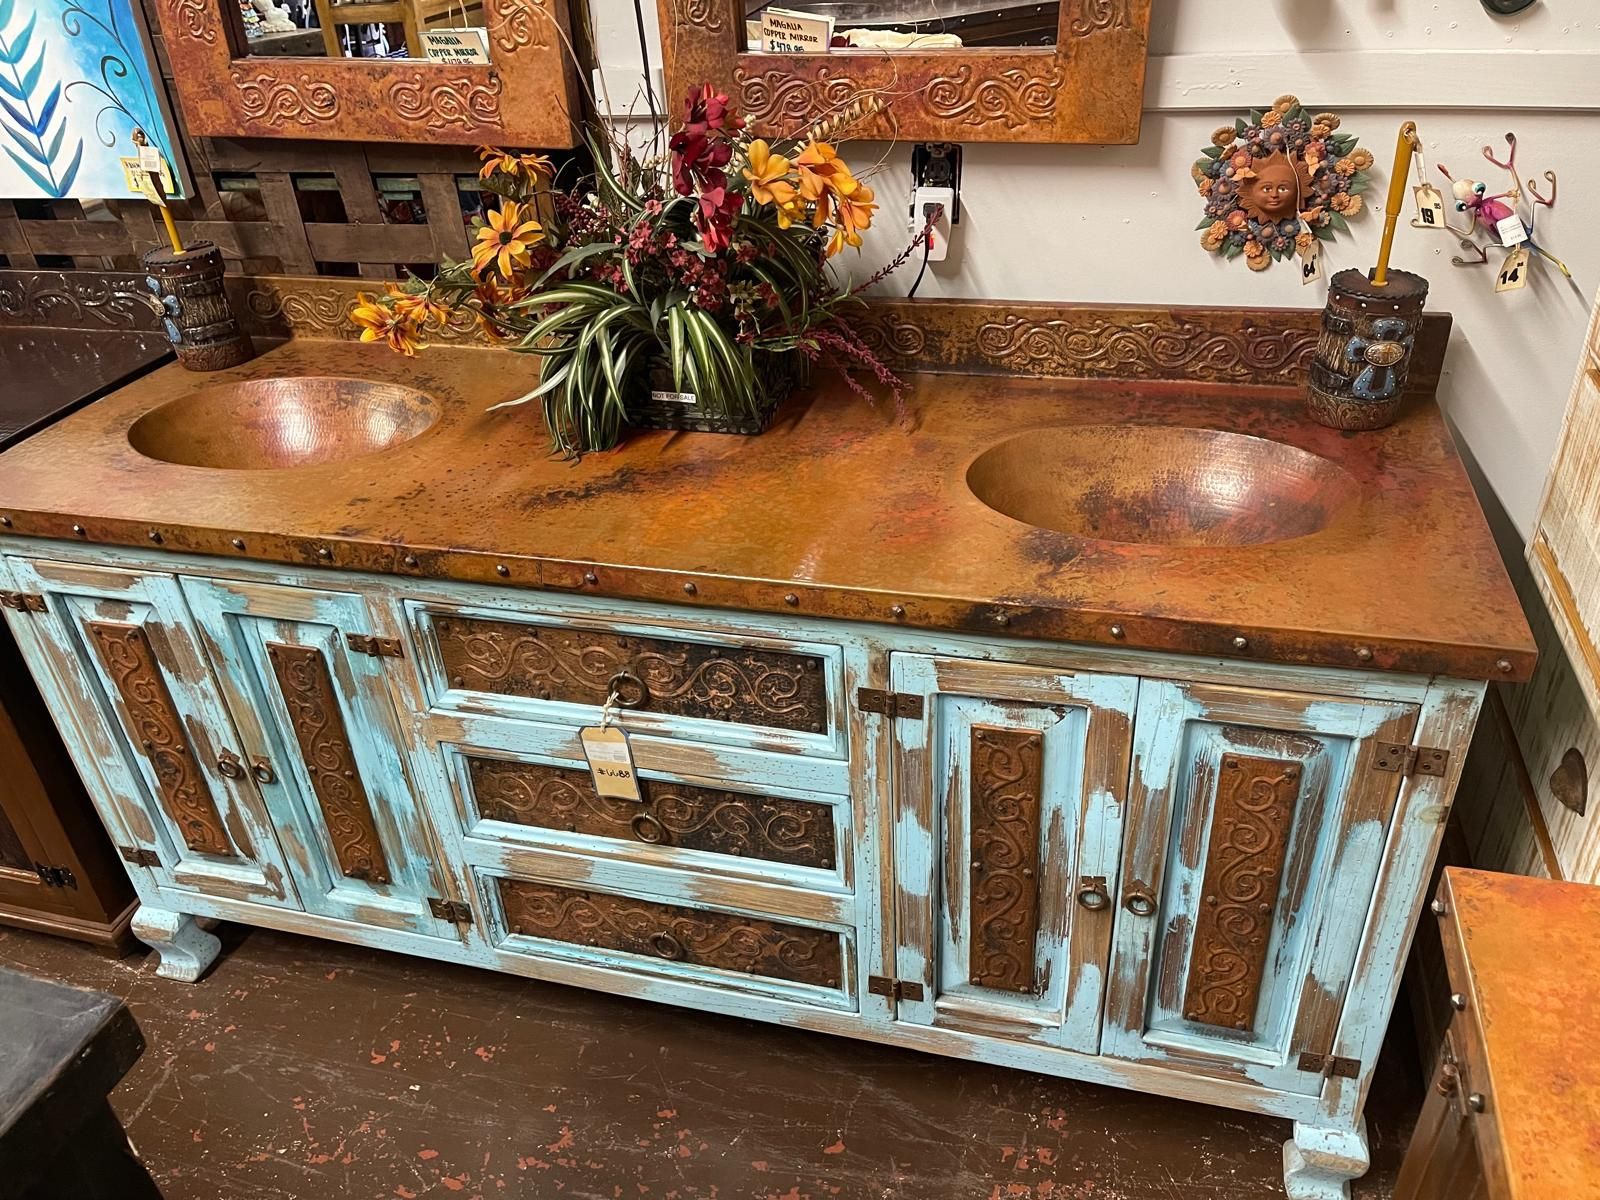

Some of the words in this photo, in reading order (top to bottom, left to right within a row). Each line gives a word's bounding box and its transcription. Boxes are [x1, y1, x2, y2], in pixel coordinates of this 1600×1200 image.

[763, 27, 786, 41] COPPER
[790, 32, 818, 43] MIRROR
[428, 48, 454, 58] COPPER
